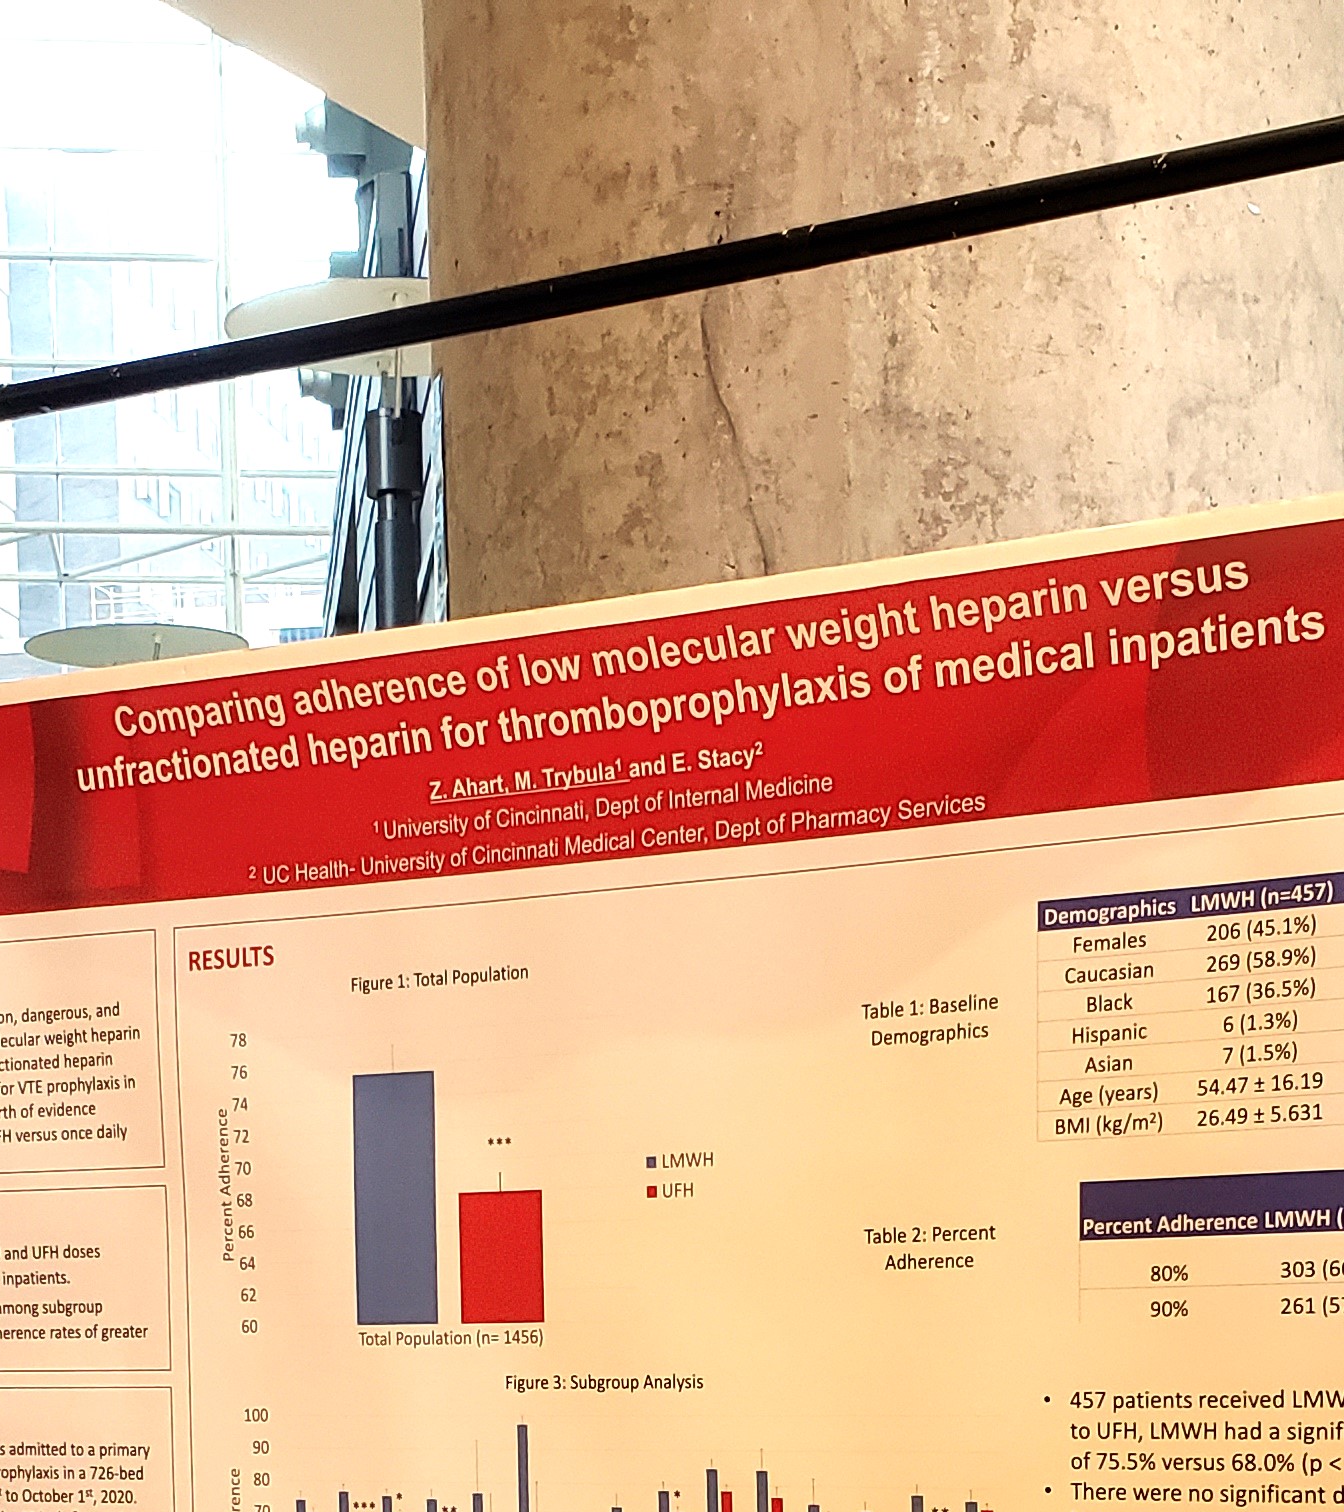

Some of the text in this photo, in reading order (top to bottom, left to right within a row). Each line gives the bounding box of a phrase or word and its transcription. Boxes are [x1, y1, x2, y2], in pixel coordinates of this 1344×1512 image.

[115, 561, 1248, 737] Comparing adherence of low molecular weight heparin versus
[77, 606, 1325, 791] unfractionated heparin for thromboprophylaxis of medical inpatients
[429, 781, 452, 804] Z.
[449, 775, 513, 802] Ahart,
[512, 771, 541, 795] M.
[629, 754, 666, 778] and
[672, 752, 692, 772] E.
[384, 774, 832, 839] University of Cincinnati, Dept of Internal Medicine
[263, 795, 985, 884] UC Health- University of Cincinnati Medical Center, Dept of Pharmacy Services
[1043, 897, 1177, 926] Demographics
[1191, 889, 1256, 913] LMWH
[1260, 880, 1334, 909] (n=457)
[1074, 932, 1146, 953] Females
[1207, 922, 1240, 941] 206
[1247, 914, 1316, 942] (45.1%)
[189, 945, 274, 971] RESULTS
[351, 965, 528, 994] Figure 1: Total Population
[21, 1008, 92, 1024] dangerous,
[96, 1001, 120, 1017] and
[861, 994, 998, 1020] Table 1: Baseline
[230, 1033, 247, 1047] 78
[872, 1022, 989, 1046] Demographics
[662, 1152, 713, 1168] LMWH
[663, 1182, 693, 1198] UFH
[1083, 1217, 1153, 1236] Percent
[1156, 1213, 1259, 1234] Adherence
[1264, 1209, 1331, 1229] LMWH
[864, 1226, 996, 1244] Table 2: Percent
[885, 1253, 974, 1270] Adherence
[1151, 1264, 1188, 1282] 80%
[1281, 1261, 1315, 1278] 303
[242, 1319, 258, 1333] 60
[506, 1373, 703, 1393] Figure 3: Subgroup Analysis
[1070, 1391, 1106, 1409] 457
[1113, 1391, 1192, 1413] patients
[1199, 1389, 1284, 1408] received
[244, 1408, 268, 1422] 100
